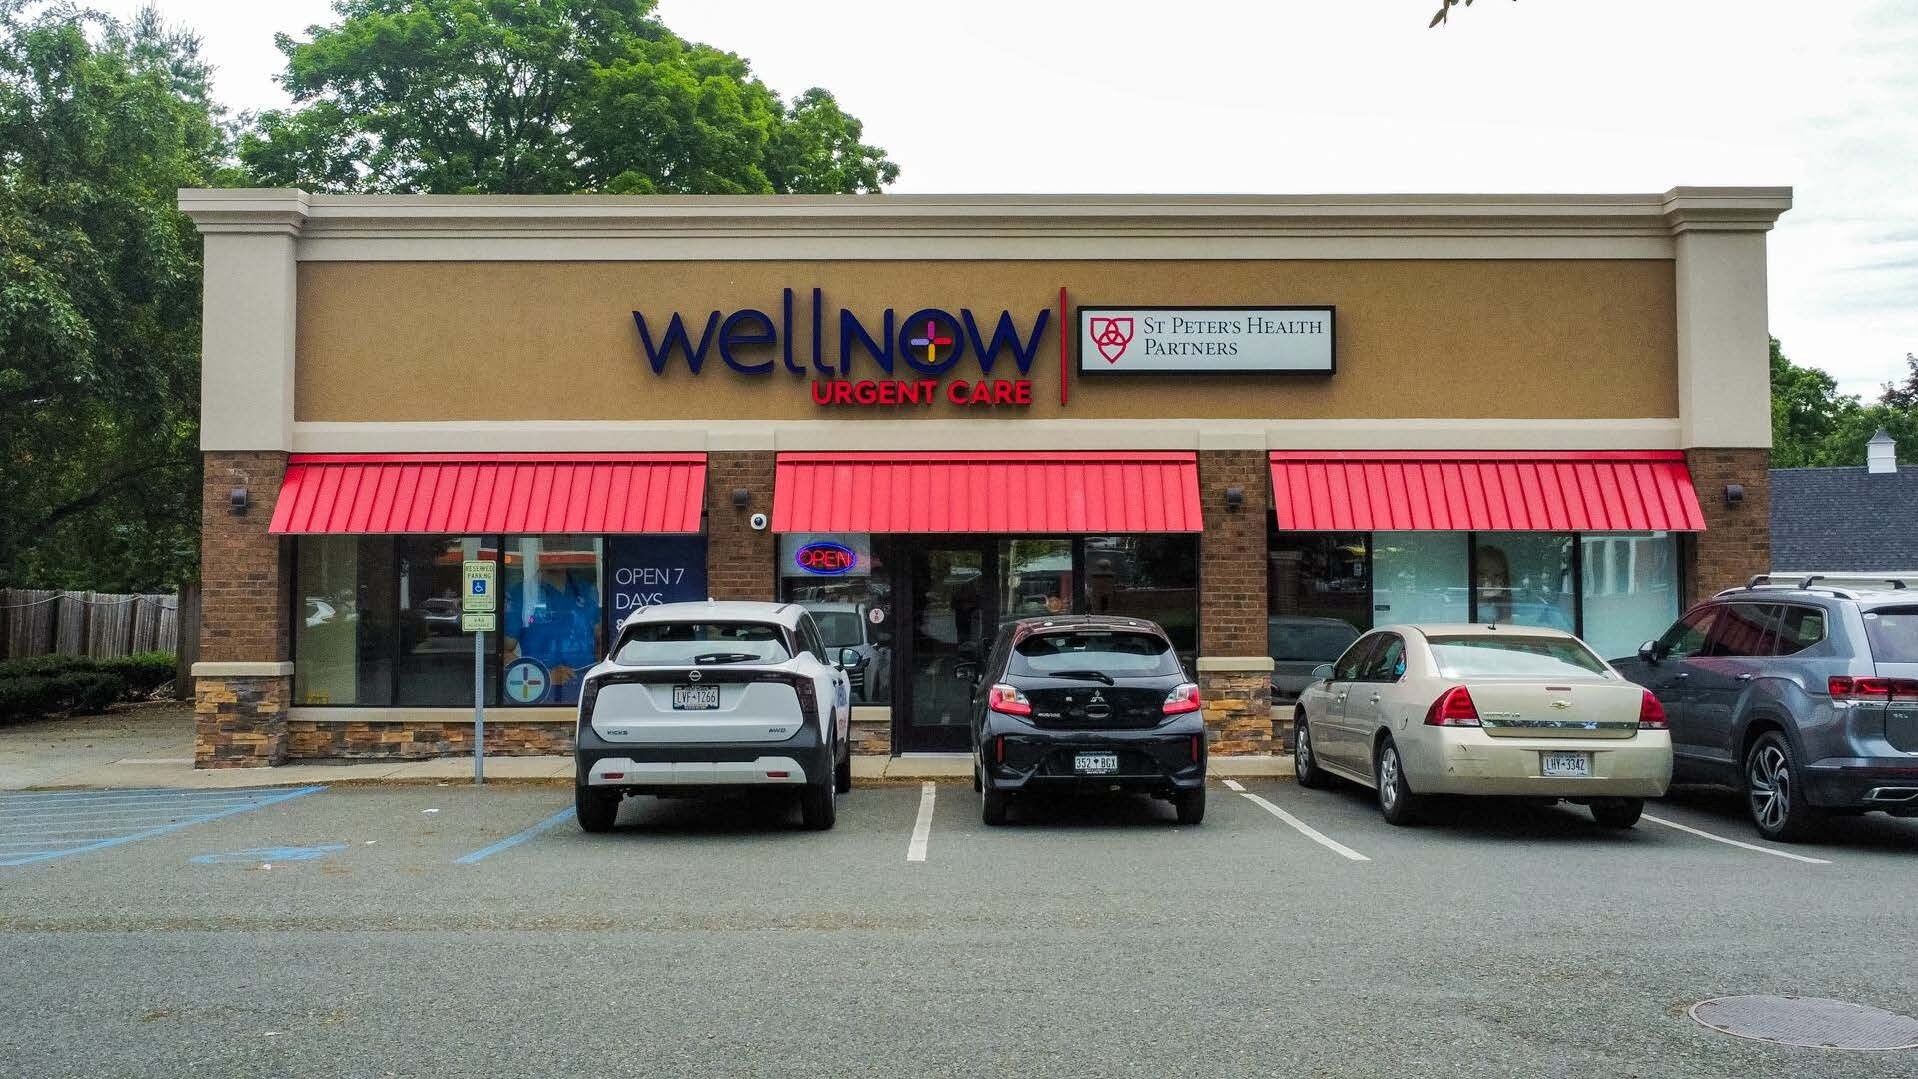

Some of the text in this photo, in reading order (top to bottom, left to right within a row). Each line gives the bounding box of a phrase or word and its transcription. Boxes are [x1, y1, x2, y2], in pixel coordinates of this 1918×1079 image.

[1248, 317, 1323, 335] HEALTH
[1144, 338, 1238, 356] PARTNERS
[812, 380, 1033, 405] URGENT CARE
[799, 549, 851, 568] OPEN
[615, 567, 685, 585] OPEN 7
[616, 593, 663, 610] DAYS
